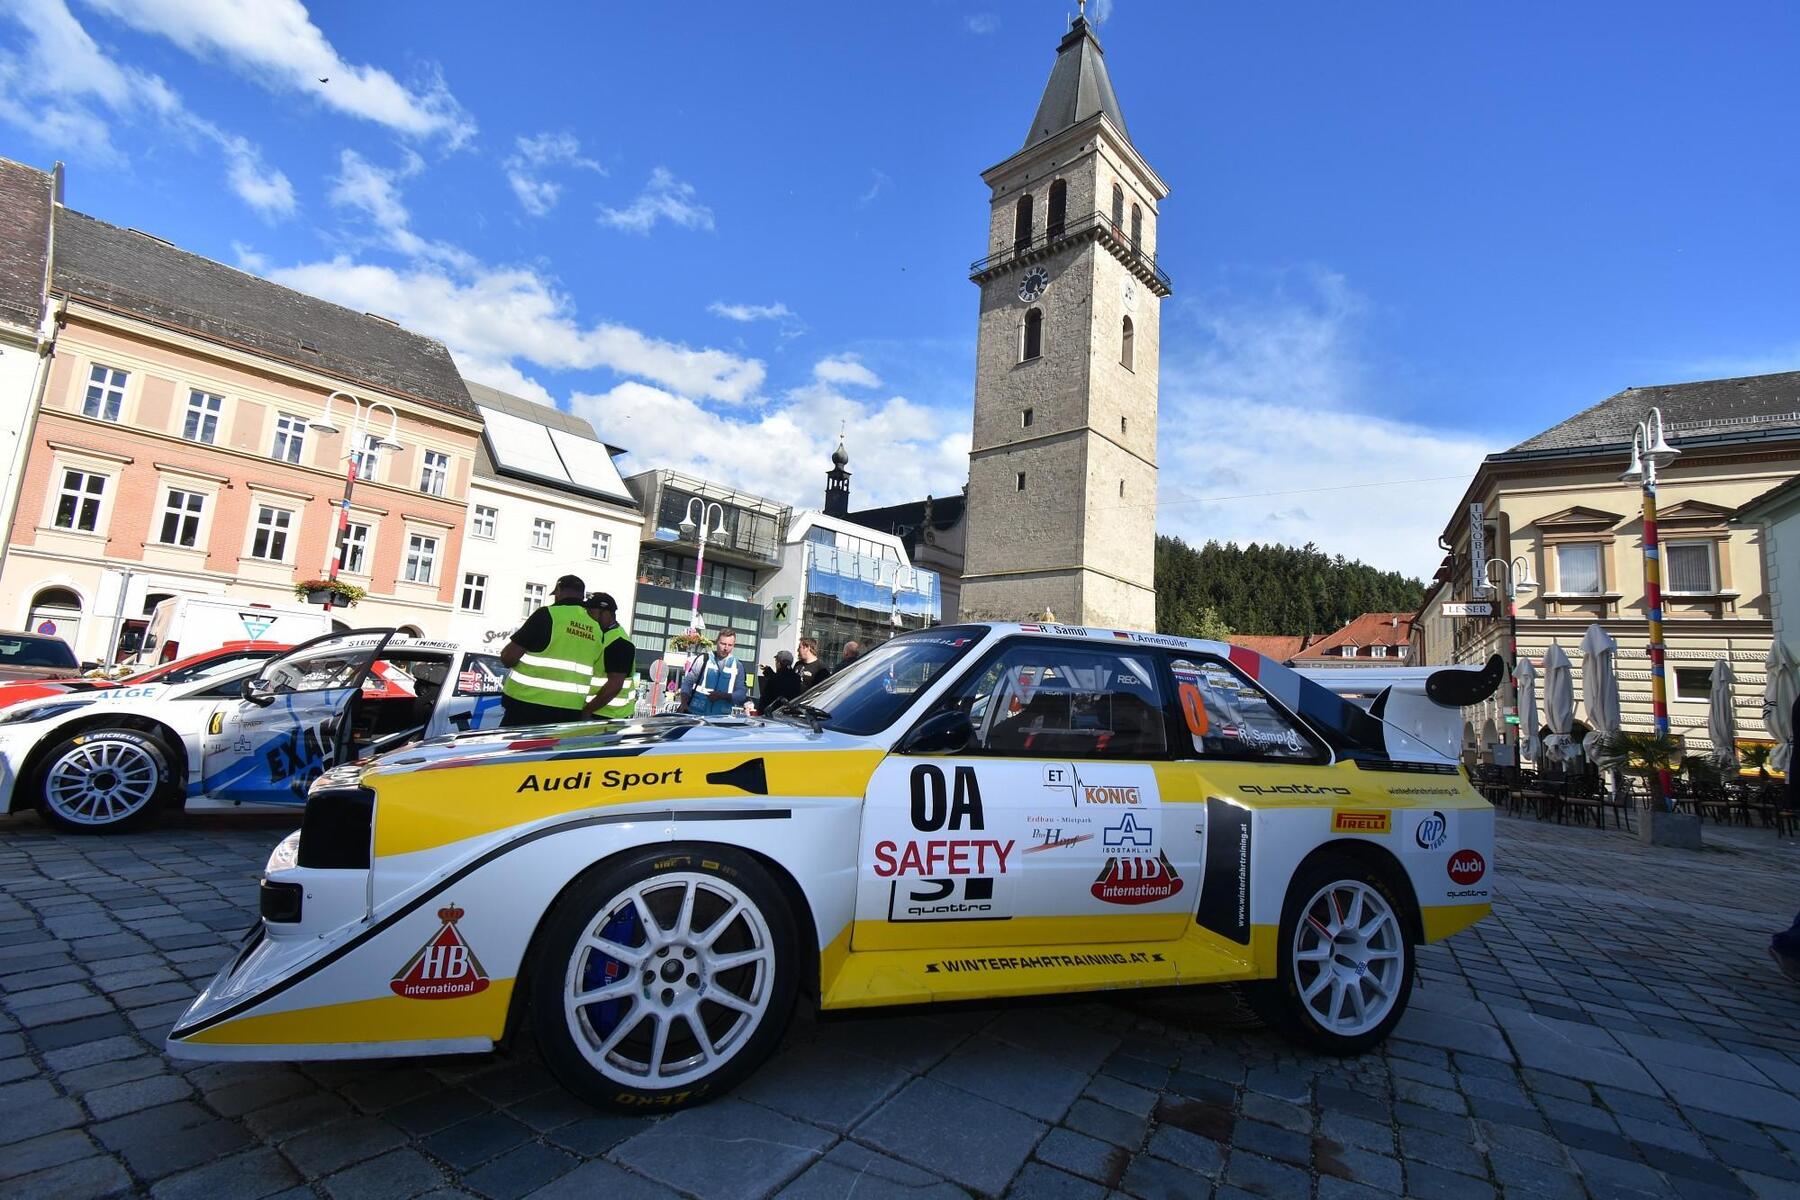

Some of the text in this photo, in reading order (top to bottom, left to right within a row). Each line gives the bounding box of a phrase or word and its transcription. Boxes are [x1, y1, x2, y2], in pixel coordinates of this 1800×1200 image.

[1448, 606, 1487, 614] LESSER
[570, 620, 593, 632] RALLYE
[1056, 626, 1088, 637] Sampl
[566, 627, 595, 642] MARSHAL
[96, 688, 156, 699] ALGE
[212, 712, 225, 734] 8
[93, 733, 143, 744] MICHELIN
[516, 767, 683, 793] Audi Sport
[1048, 770, 1063, 781] ET
[1085, 785, 1138, 804] KÖNIG
[1238, 785, 1351, 795] quattro
[1336, 813, 1386, 830] PIRELLI
[1422, 820, 1442, 841] RP
[873, 840, 1015, 877] SAFETY
[1452, 859, 1482, 873] Audi
[1238, 823, 1249, 927] www.winterfahrtraining.at
[1103, 884, 1171, 897] international
[1447, 889, 1488, 899] quattro
[908, 903, 992, 916] quattro
[421, 945, 469, 979] HB
[942, 952, 1149, 973] WINTERFAHRTRAINING.AT
[404, 981, 474, 995] international
